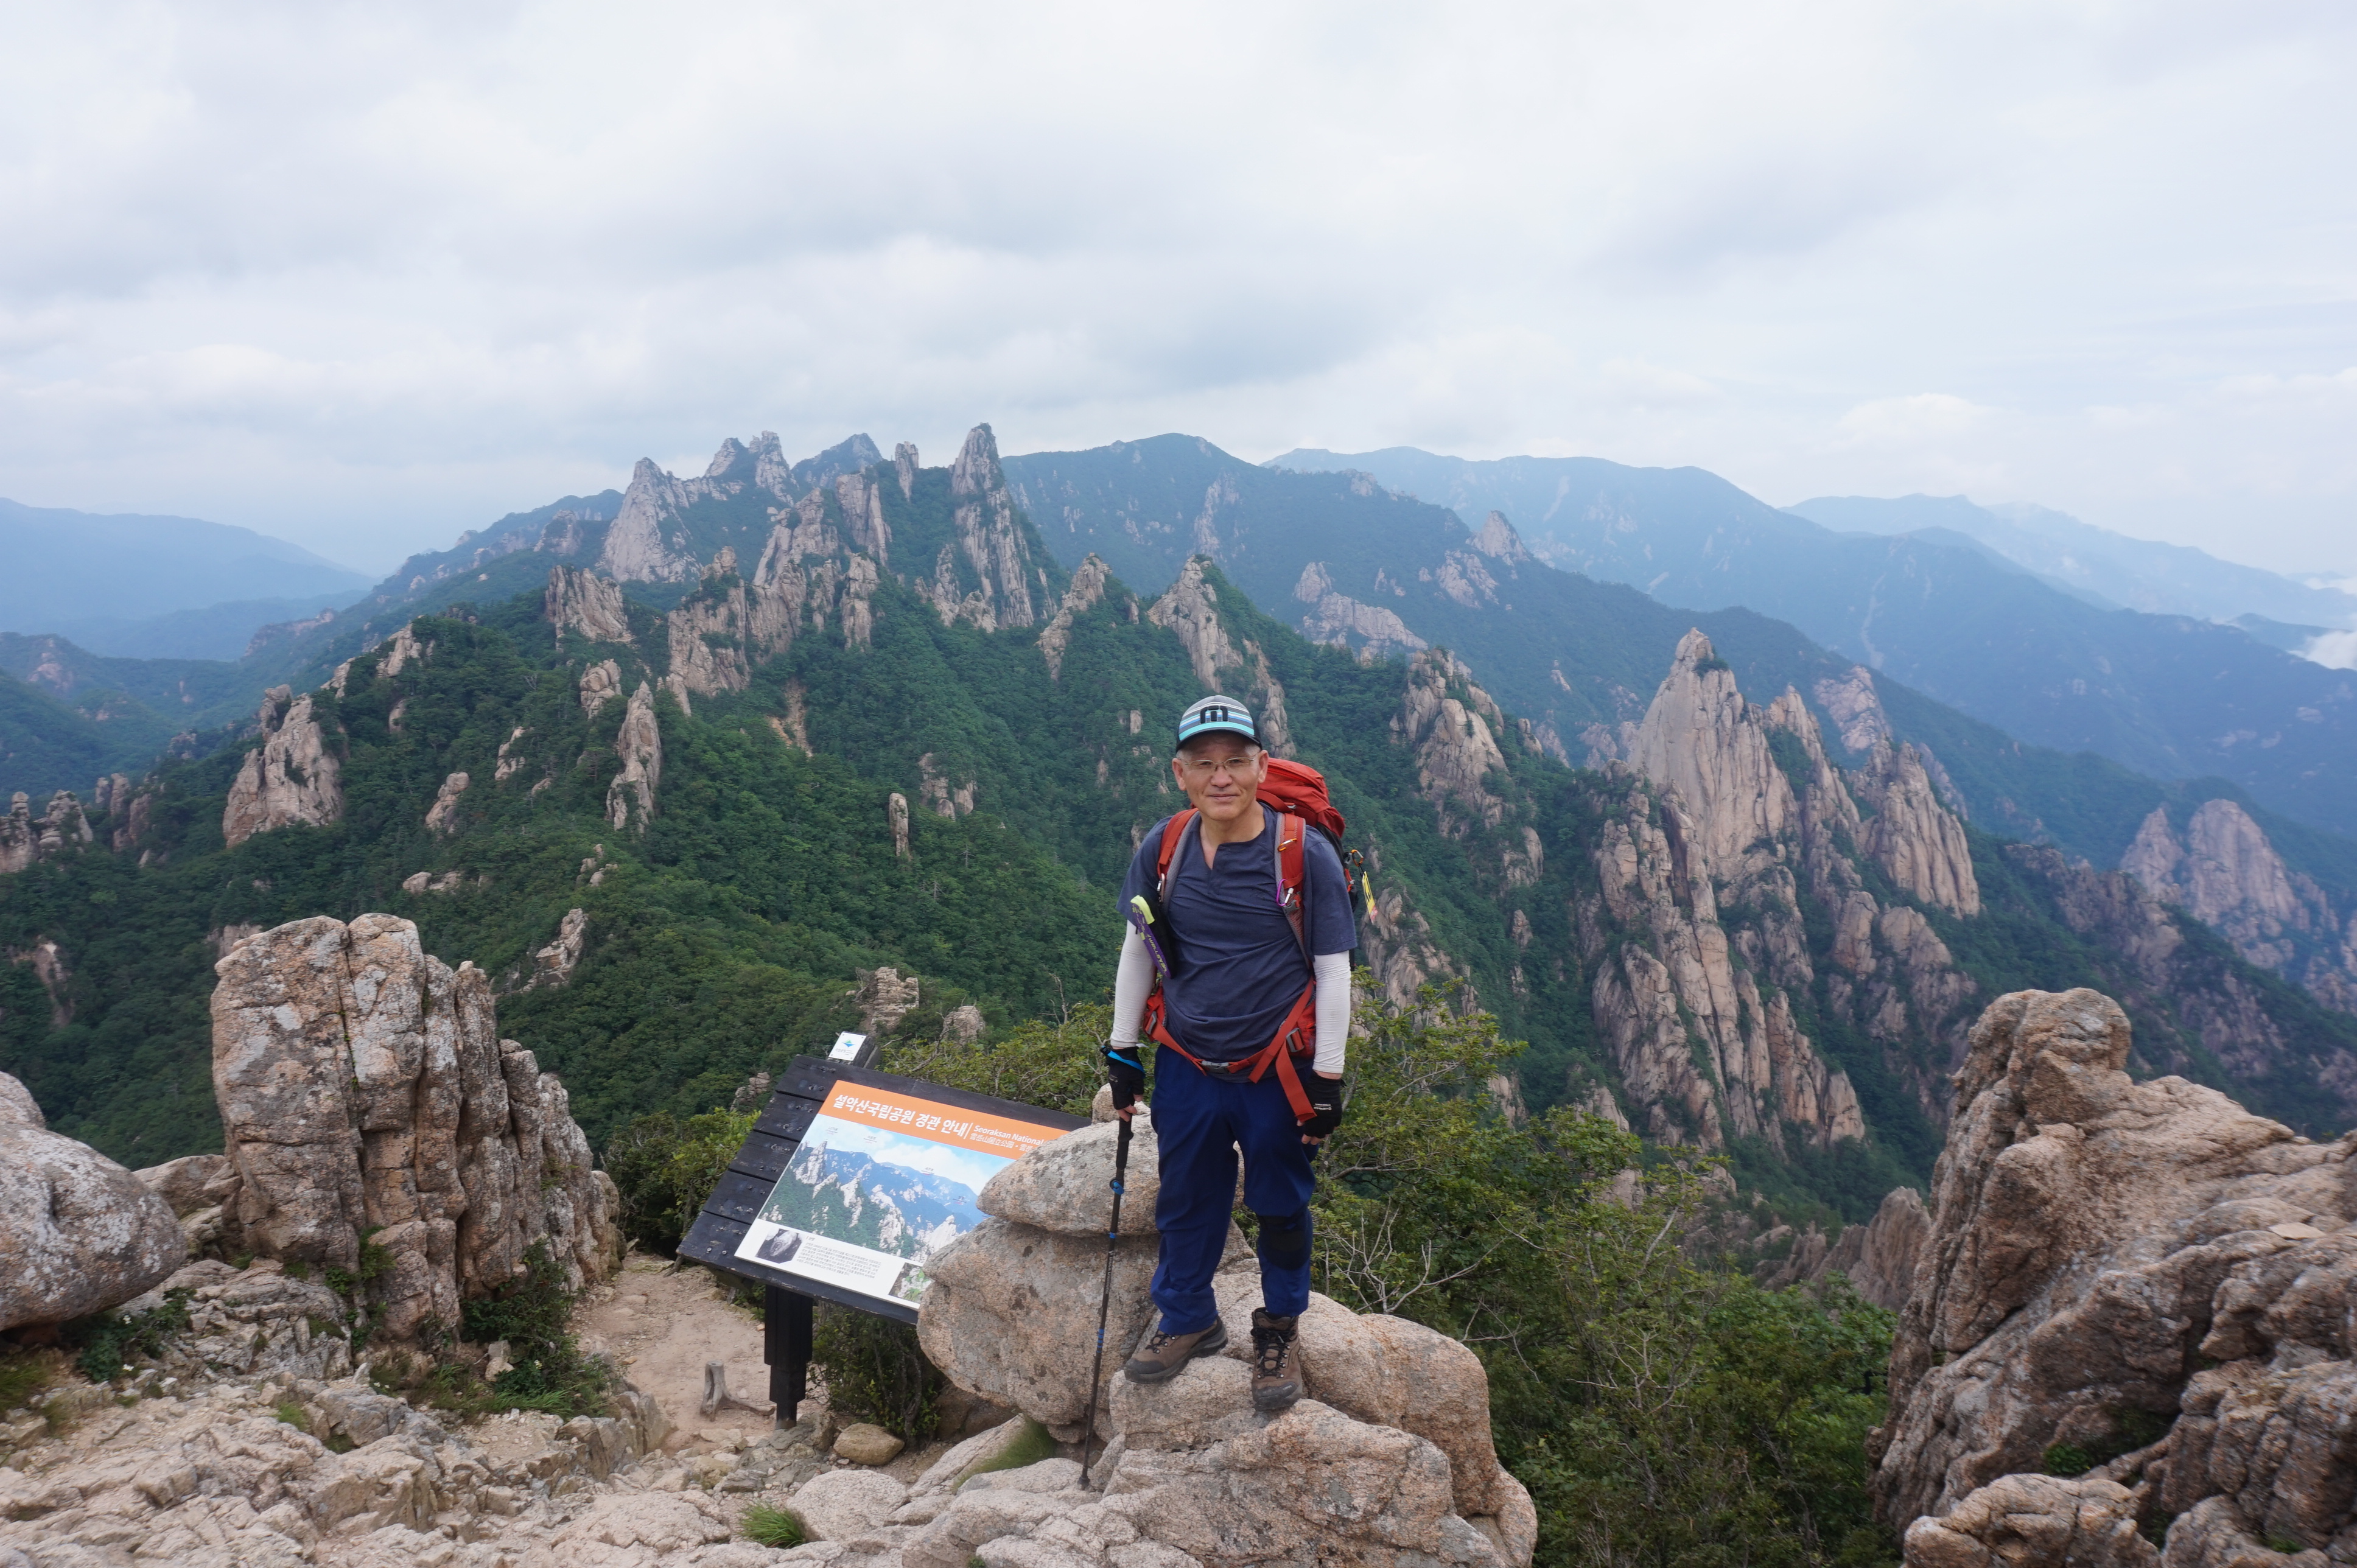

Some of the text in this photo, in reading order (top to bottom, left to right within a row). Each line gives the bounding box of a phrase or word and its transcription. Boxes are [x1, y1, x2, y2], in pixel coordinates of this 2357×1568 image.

[833, 1094, 969, 1138] 설악산국립공원 경관 안내
[973, 1125, 1045, 1146] Seoraksan National
